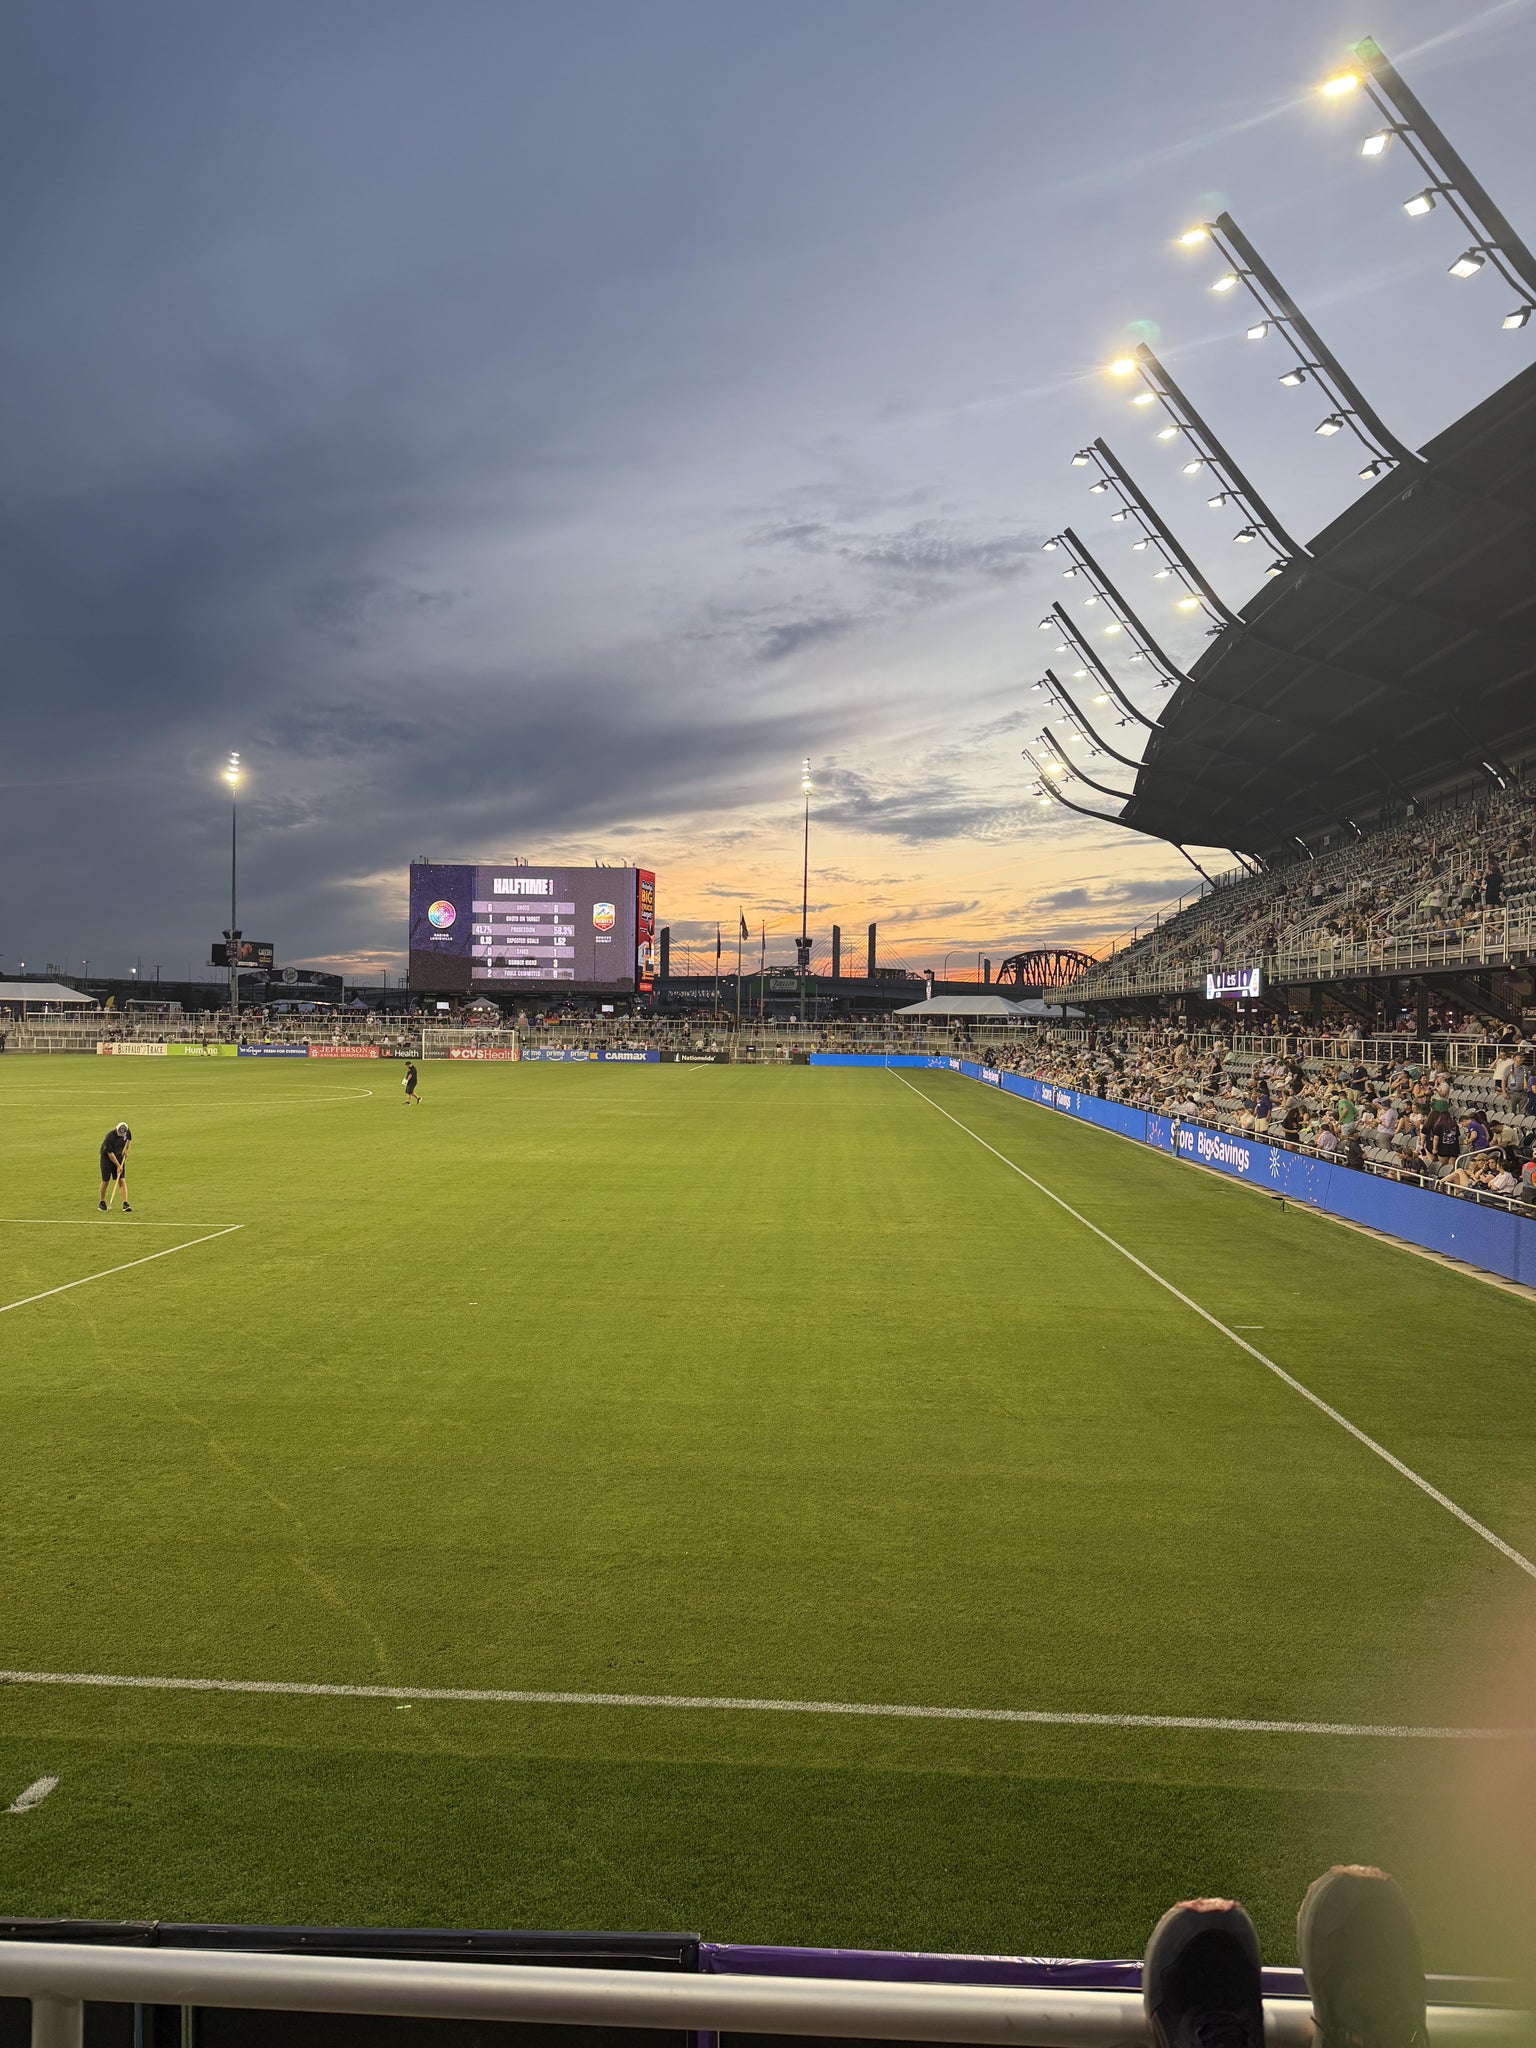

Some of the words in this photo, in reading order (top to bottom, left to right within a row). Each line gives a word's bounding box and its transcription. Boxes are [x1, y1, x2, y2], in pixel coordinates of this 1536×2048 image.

[494, 878, 548, 895] HALFTIME
[641, 889, 653, 905] BIG
[489, 914, 493, 923] 1
[475, 925, 493, 934] 41.7%
[487, 969, 493, 978] 2
[147, 1044, 163, 1054] TRACE
[185, 1046, 218, 1054] Humna
[395, 1050, 419, 1058] Health
[546, 1050, 565, 1058] prime
[570, 1050, 589, 1058] prime
